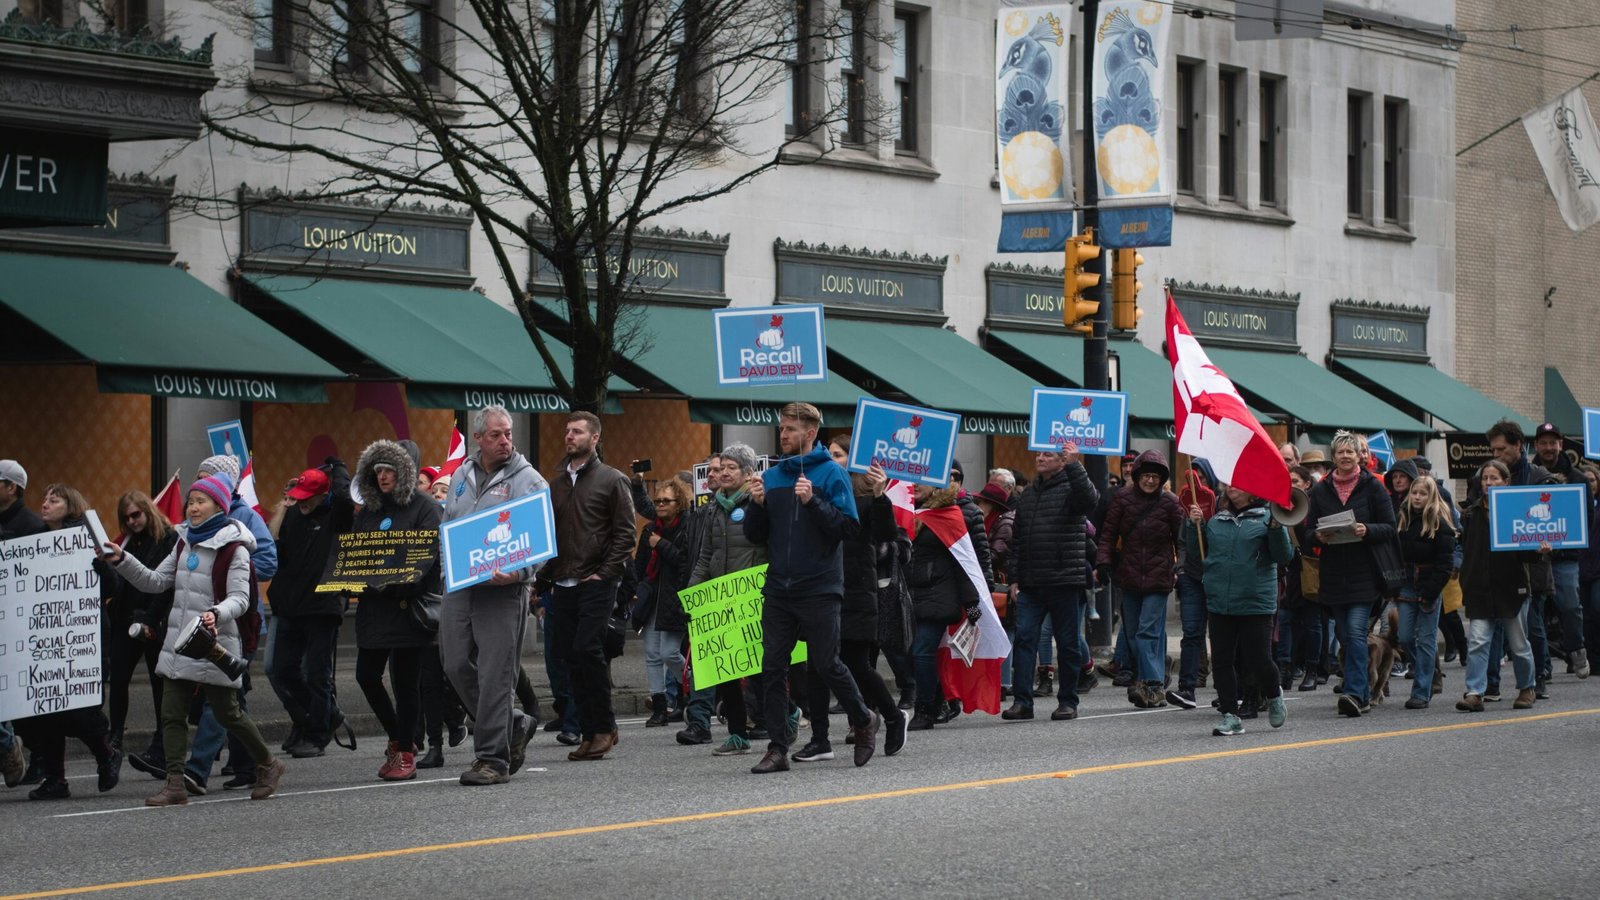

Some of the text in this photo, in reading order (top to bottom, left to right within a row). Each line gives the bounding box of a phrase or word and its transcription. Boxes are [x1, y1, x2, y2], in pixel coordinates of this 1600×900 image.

[304, 226, 416, 255] LOUIS VUITTON
[822, 274, 904, 298] LOUIS VUITTON
[1026, 294, 1054, 312] LOUIS
[1204, 310, 1266, 330] LOUIS VUITTON
[1352, 324, 1408, 342] LOUIS VUITTON
[740, 346, 802, 366] Recall
[740, 364, 804, 377] DAVID EBY
[154, 374, 276, 398] LOUIS VUITTON
[465, 390, 505, 409] LOUIS
[736, 406, 772, 423] LOUIS
[964, 416, 1030, 434] LOUIS VUITTO
[1052, 420, 1104, 438] Recall
[1084, 438, 1104, 446] EBY
[874, 440, 932, 466] Recall
[908, 464, 930, 476] EBY
[1513, 518, 1566, 534] Recall
[36, 538, 51, 554] for
[1512, 532, 1567, 543] DAVID EBY
[470, 532, 530, 566] Recall
[470, 557, 506, 576] DAVID
[509, 548, 532, 563] EBY
[35, 570, 98, 592] DIGITAL ID
[32, 597, 100, 616] CENTRAL BANK
[684, 583, 718, 611] BODILY
[29, 615, 64, 630] DIGITAL
[690, 607, 736, 637] FREEDOM
[32, 643, 96, 661] SCORE (CHINA)
[698, 632, 733, 660] BASIC
[34, 696, 69, 715] (KTDI)
